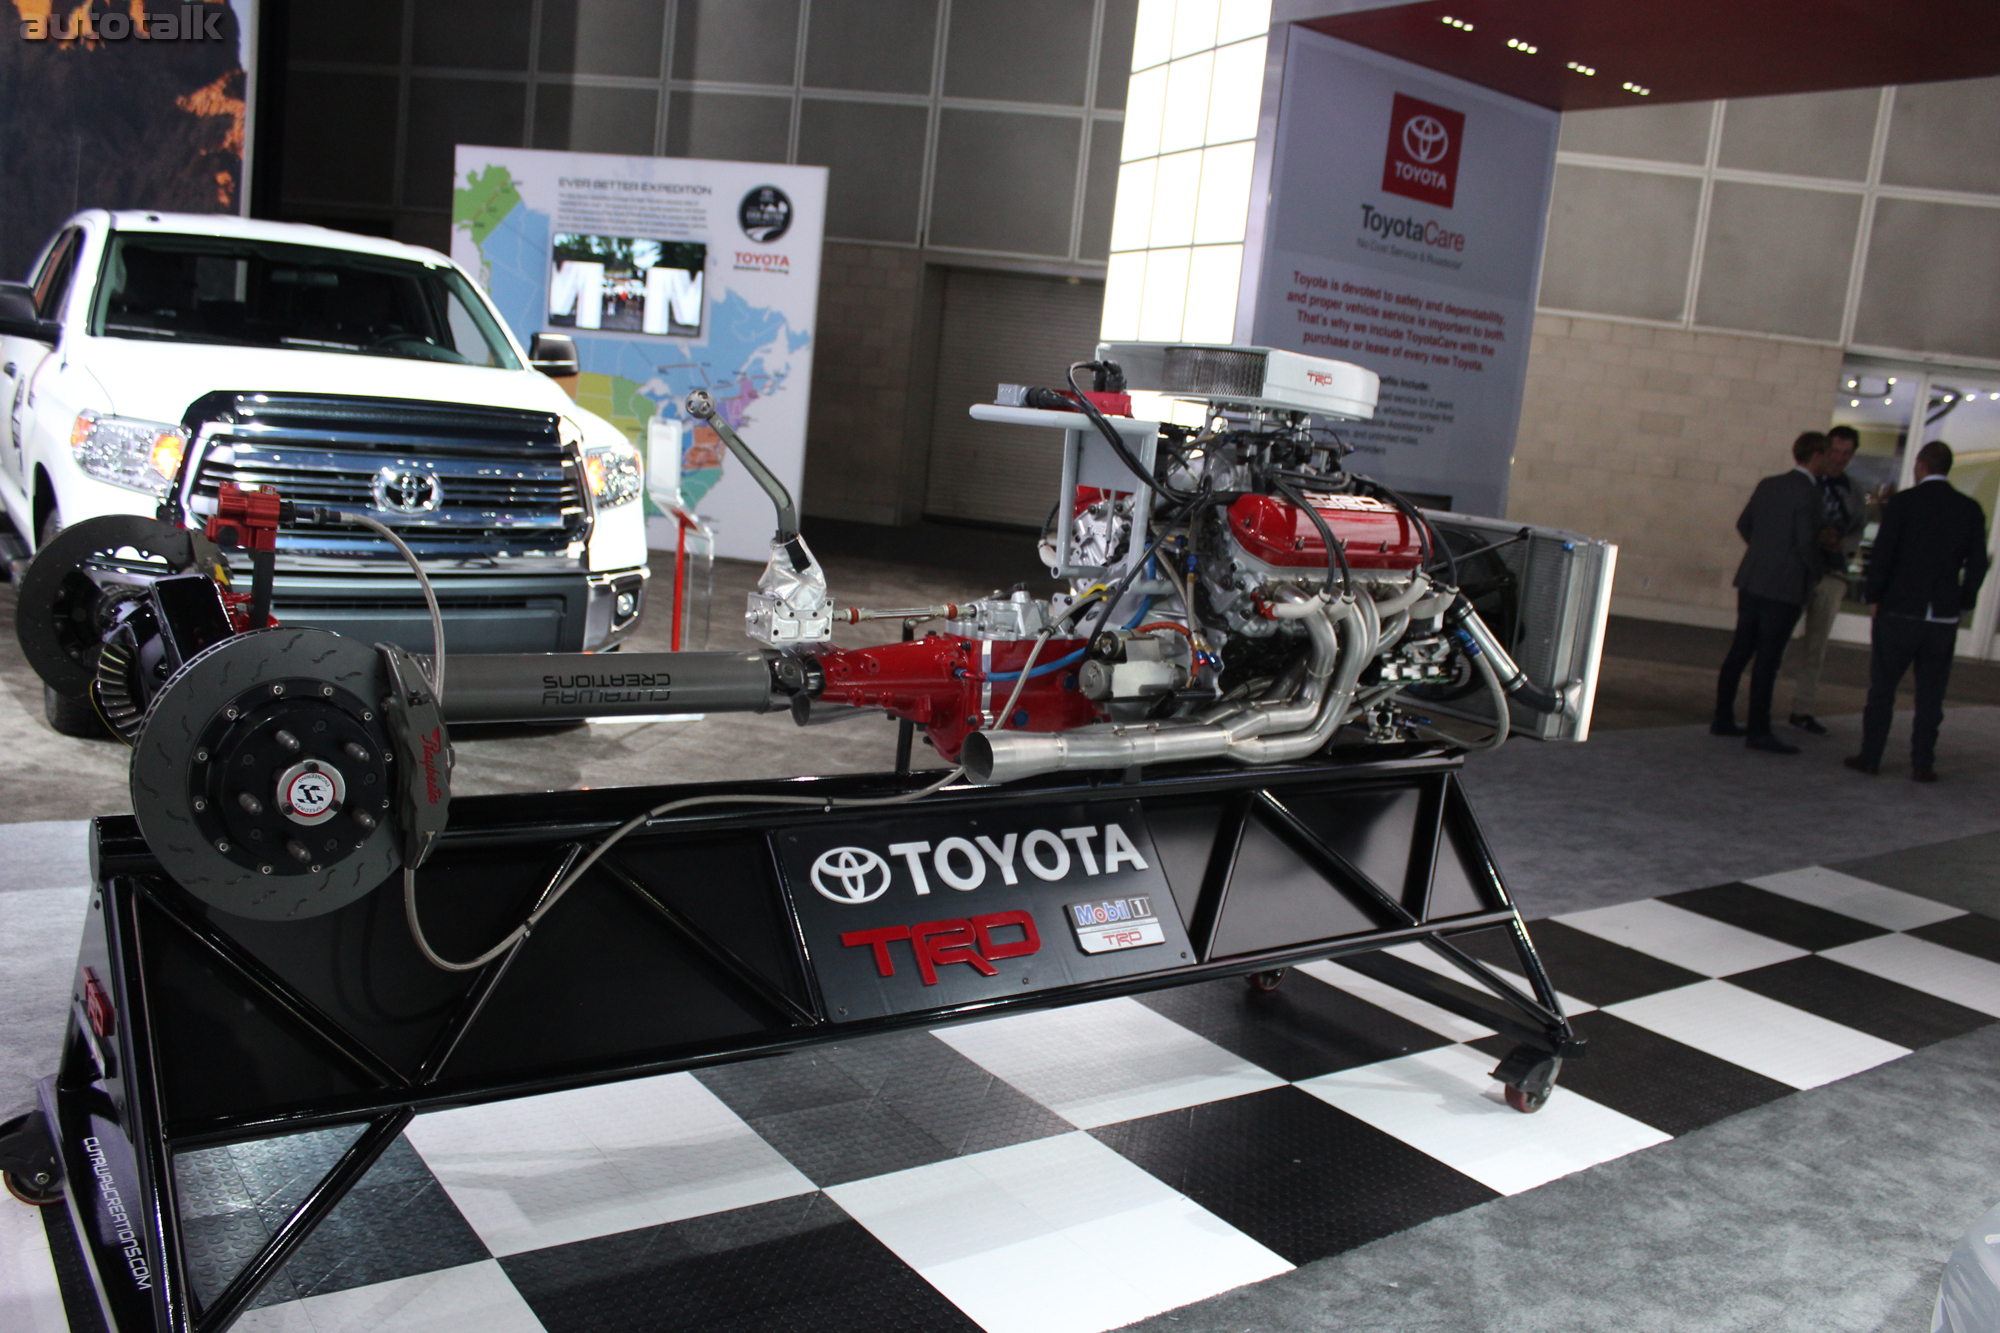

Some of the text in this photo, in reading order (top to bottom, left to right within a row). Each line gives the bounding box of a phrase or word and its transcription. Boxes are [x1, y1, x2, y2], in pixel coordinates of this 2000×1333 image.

[558, 177, 712, 195] EVER BETTER EXPEDITION
[1395, 161, 1447, 190] TOYOTA
[1361, 203, 1465, 253] ToyotaCare
[735, 251, 790, 267] TOYOTA
[1294, 270, 1328, 289] Toyota
[1331, 278, 1339, 291] is
[1342, 282, 1381, 300] devoted
[1384, 290, 1393, 302] to
[1426, 301, 1443, 312] and
[1287, 292, 1307, 304] and
[1309, 296, 1342, 311] proper
[1345, 302, 1380, 318] vehicle
[1382, 309, 1416, 325] service
[1418, 315, 1426, 327] is
[1428, 318, 1472, 335] important
[1473, 326, 1483, 337] to
[1298, 309, 1495, 357] That's why we include ToyotaCare with the
[1303, 332, 1350, 349] purchase
[1352, 340, 1363, 350] or
[1365, 341, 1390, 355] lease
[1392, 346, 1403, 357] of
[1404, 350, 1429, 365] every
[1431, 354, 1450, 365] new
[1307, 372, 1333, 386] TRD
[542, 673, 671, 689] CREATIONS
[888, 823, 1149, 896] TOYOTA
[1074, 899, 1131, 926] Mobil
[841, 909, 1042, 986] TRD
[1102, 931, 1142, 947] TRD
[83, 1136, 152, 1291] CUTAWAYCREATIONS.COM
